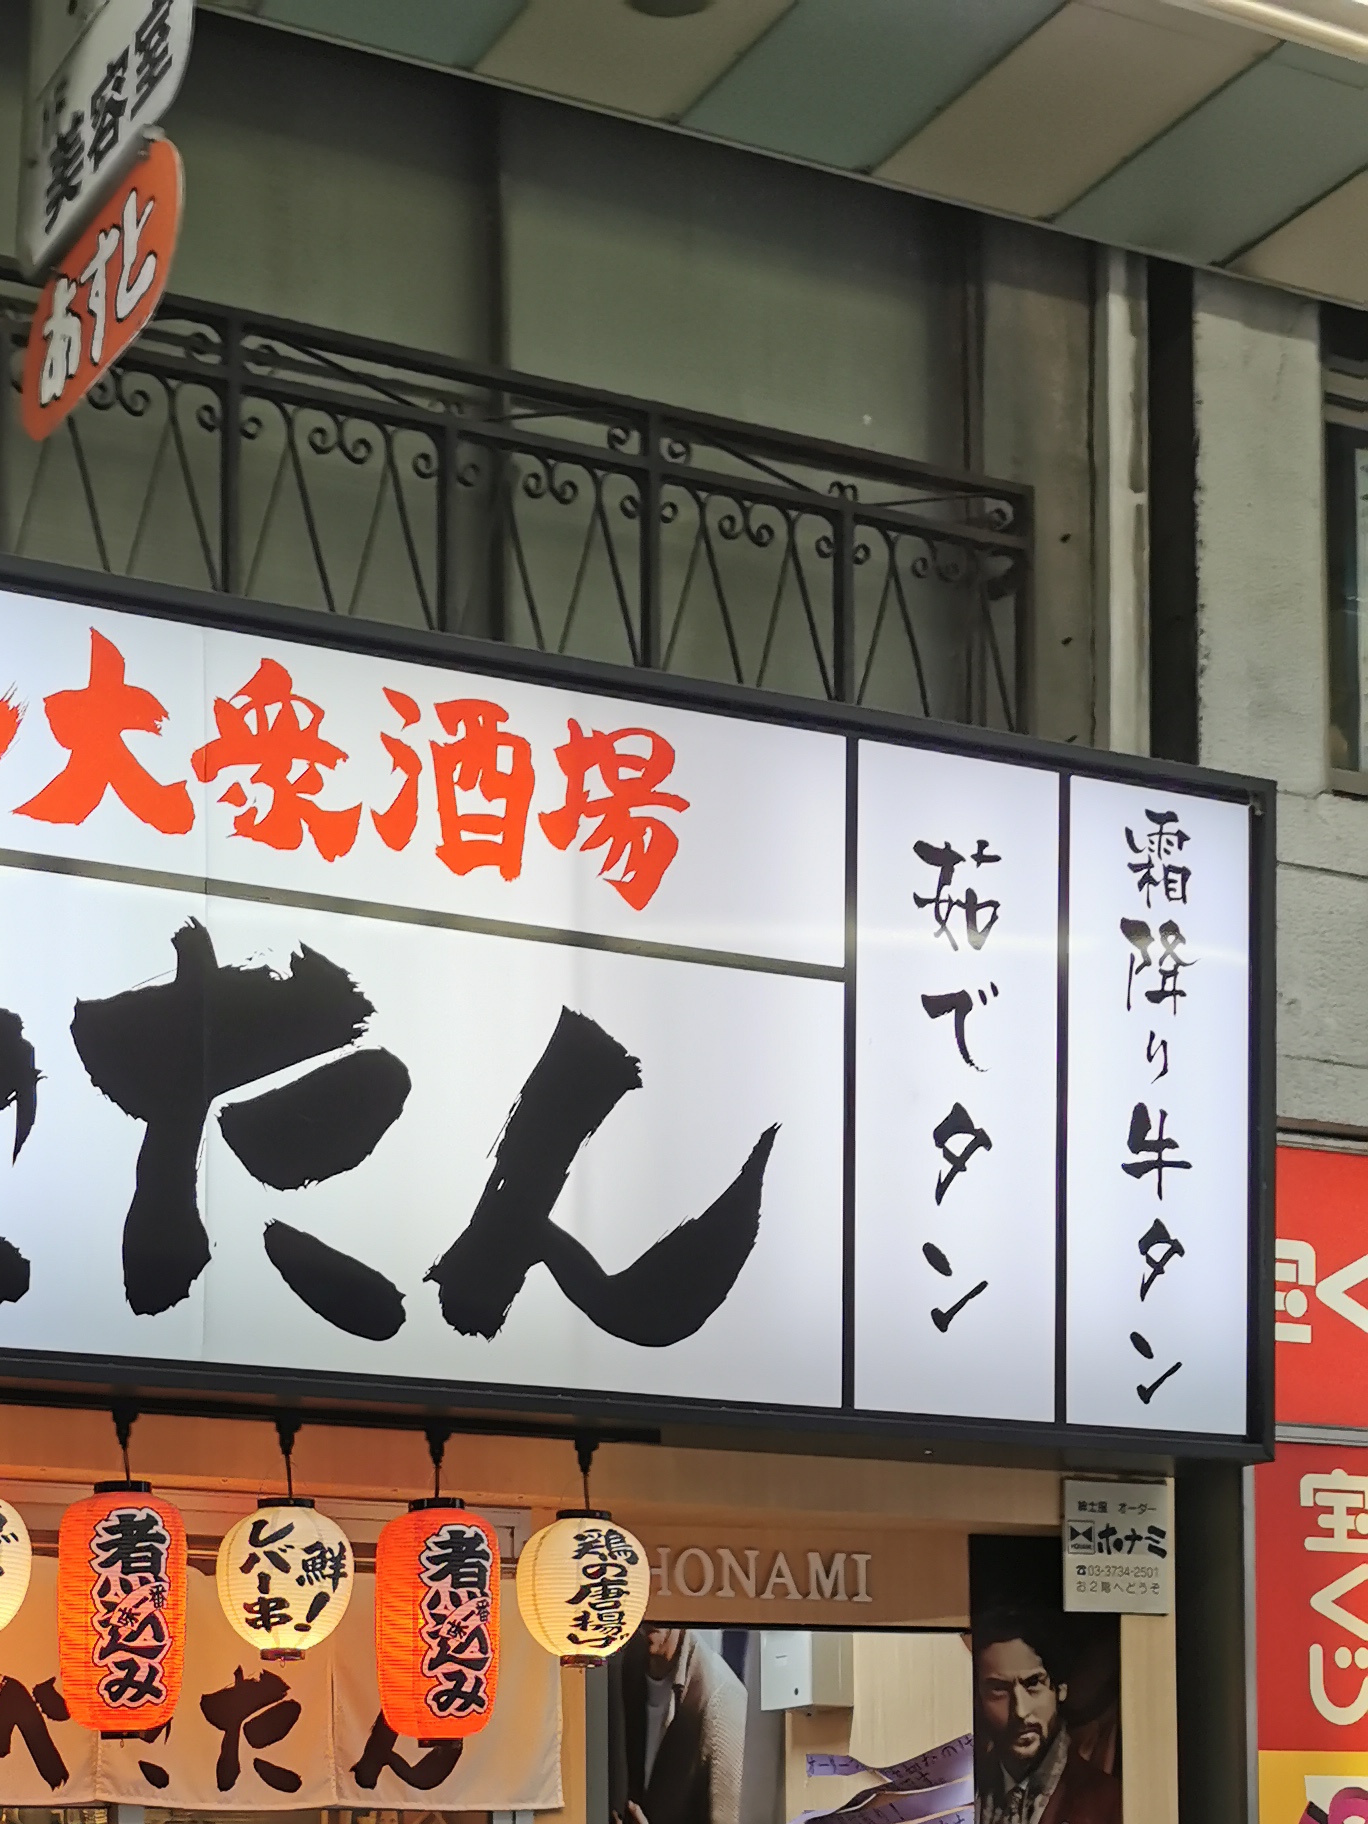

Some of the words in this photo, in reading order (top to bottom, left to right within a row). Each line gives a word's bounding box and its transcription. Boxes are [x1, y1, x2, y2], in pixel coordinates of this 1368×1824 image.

[913, 840, 1001, 1333] 茹でタン
[1121, 809, 1201, 1405] 霜降り牛タン
[1097, 1523, 1167, 1559] ホナミ
[1118, 1502, 1157, 1516] オーダー
[239, 1519, 295, 1634] レバー串
[564, 1529, 640, 1652] 鶏の唐揚げ
[650, 1546, 873, 1603] HONAMI
